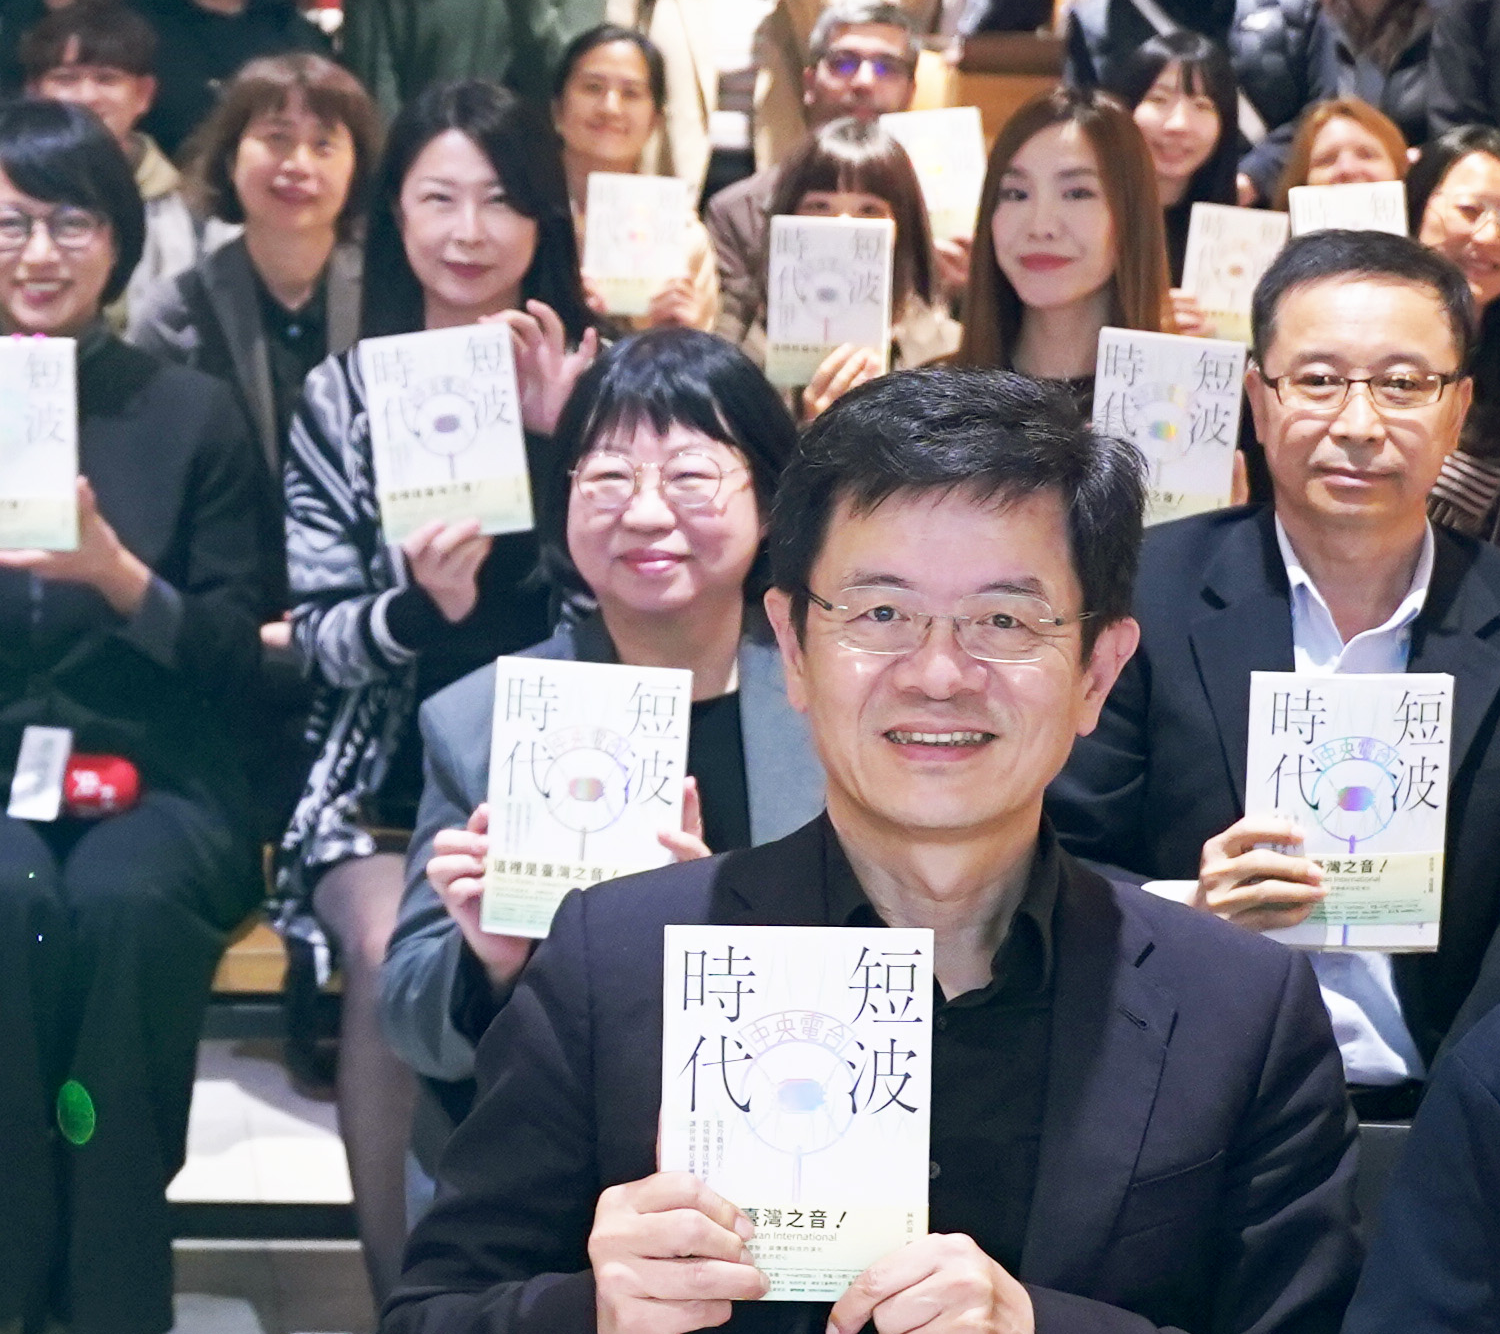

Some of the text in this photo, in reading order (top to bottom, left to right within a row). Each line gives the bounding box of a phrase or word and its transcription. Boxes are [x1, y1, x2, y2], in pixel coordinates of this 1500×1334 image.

[1099, 343, 1143, 438] 時代
[1189, 350, 1237, 447] 短波
[500, 676, 559, 799] 時代
[623, 681, 681, 806] 短波
[1265, 688, 1327, 811] 時代
[1392, 689, 1446, 812] 短波
[677, 945, 756, 1113] 時代
[847, 946, 923, 1115] 短波
[773, 1230, 838, 1243] International
